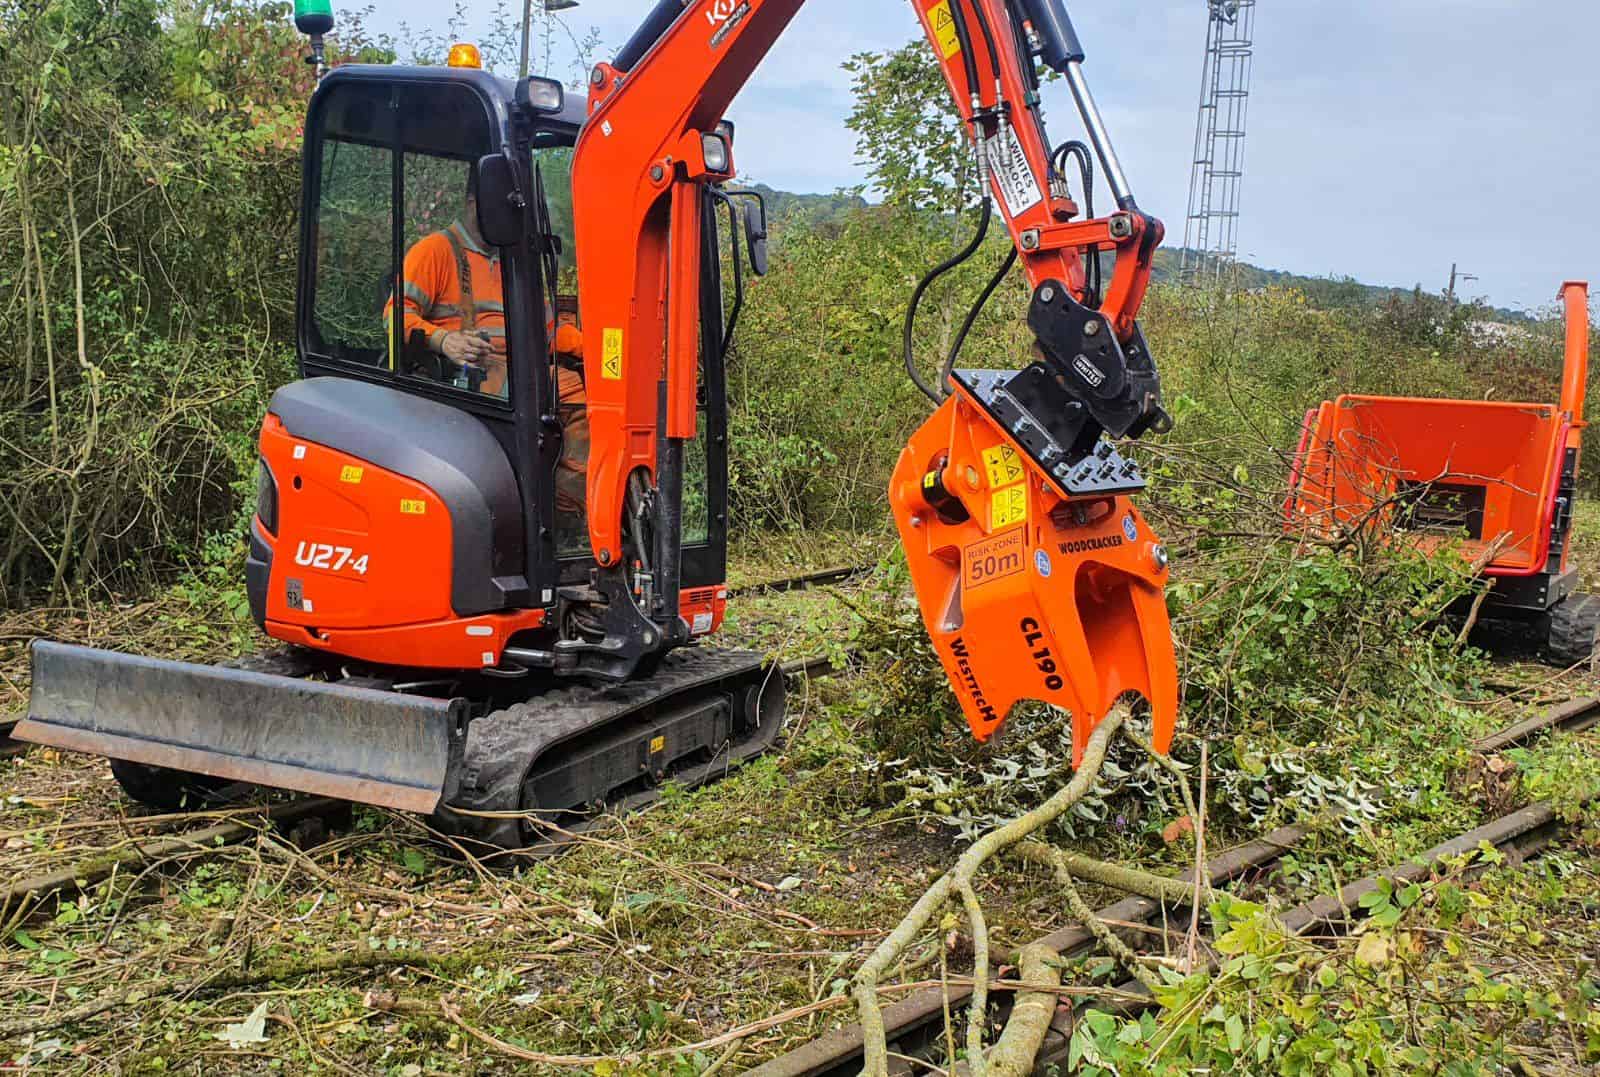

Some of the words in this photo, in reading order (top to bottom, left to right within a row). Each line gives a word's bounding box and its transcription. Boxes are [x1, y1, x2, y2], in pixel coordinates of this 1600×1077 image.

[1010, 139, 1034, 188] WHITES
[1058, 536, 1122, 554] WOODCRACKER
[971, 552, 1019, 580] 50m
[1020, 617, 1043, 647] CL
[1032, 647, 1063, 691] 190
